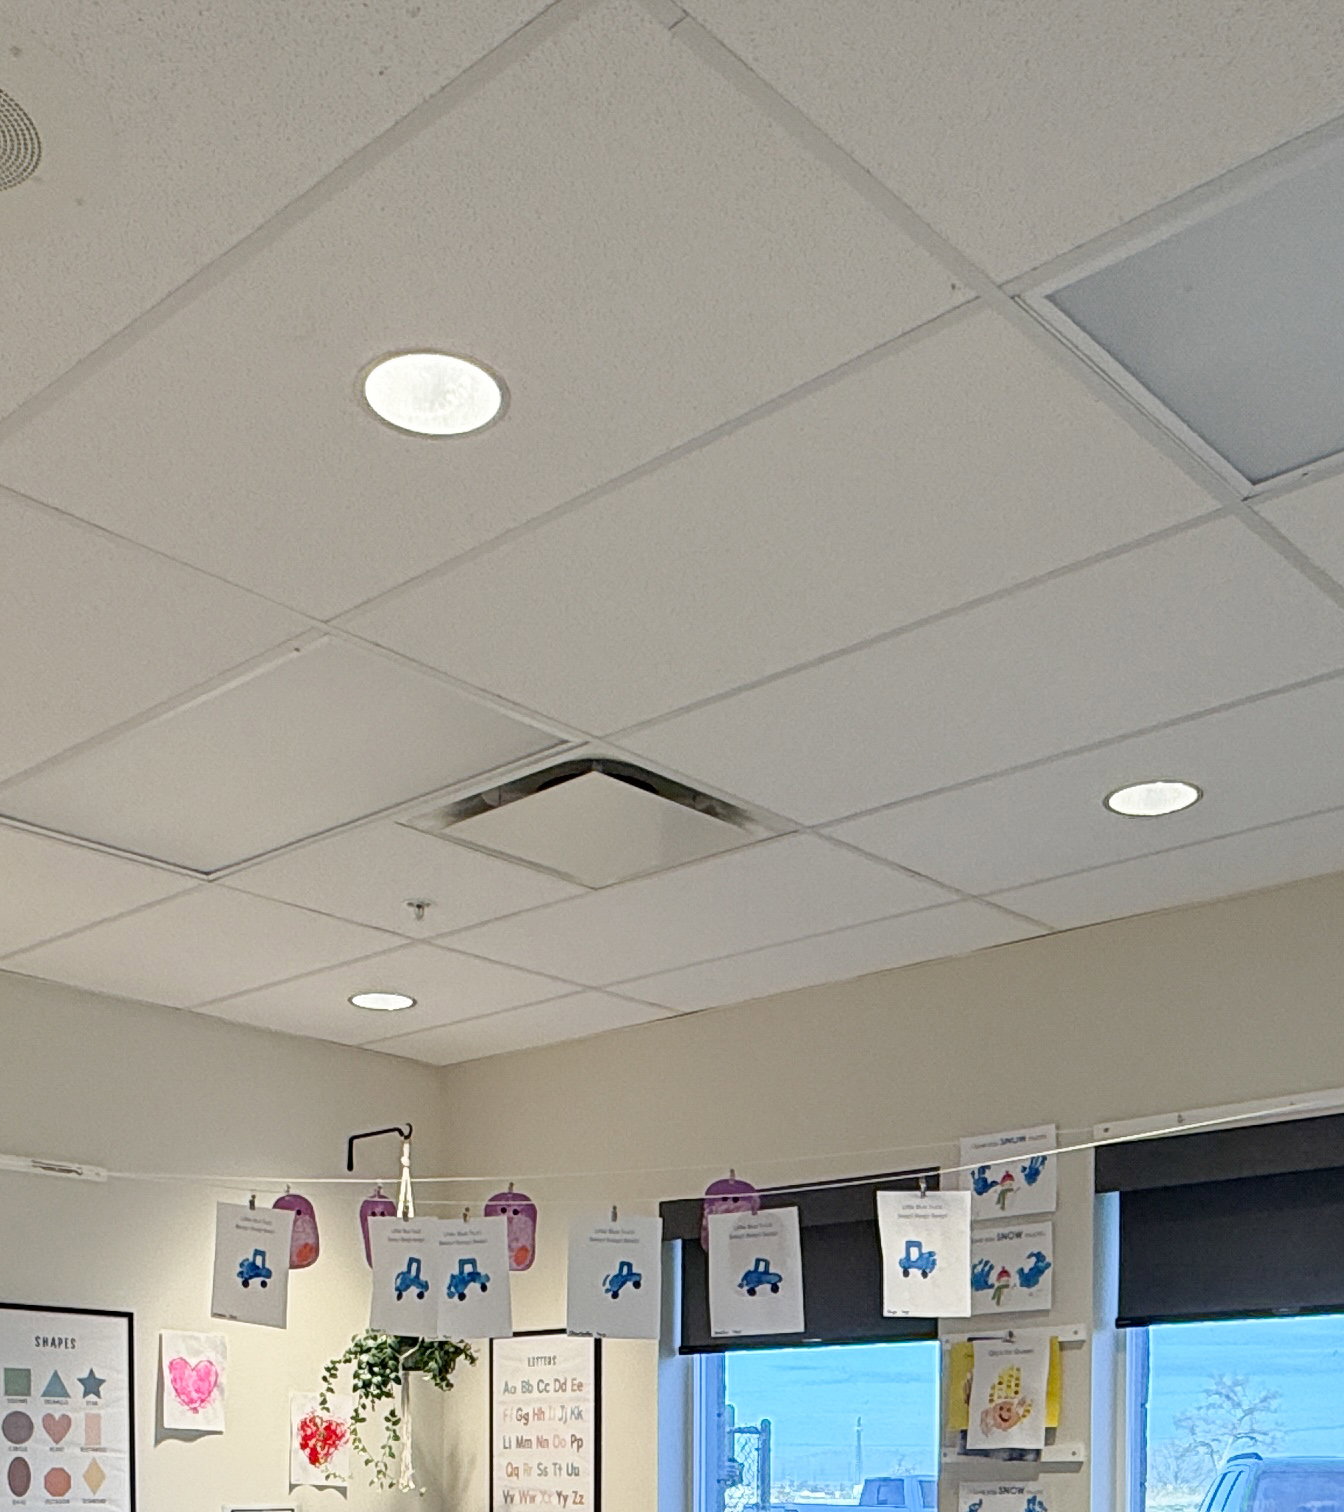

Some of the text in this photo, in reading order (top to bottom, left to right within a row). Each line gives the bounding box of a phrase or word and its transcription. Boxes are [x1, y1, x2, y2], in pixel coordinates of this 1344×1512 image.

[997, 1231, 1023, 1240] SNOW
[34, 1336, 76, 1349] SHAPES
[503, 1378, 583, 1394] Aa Bb Cc Dd Ee
[516, 1407, 529, 1425] Gg
[533, 1407, 545, 1421] Hh
[558, 1405, 568, 1424] Jj
[570, 1406, 583, 1421] Kk
[516, 1435, 532, 1449] Mm
[536, 1435, 549, 1449] Nn
[552, 1434, 566, 1448] Oo
[570, 1434, 583, 1452] Pp
[506, 1462, 519, 1480] Qq
[537, 1462, 548, 1477] Ss
[552, 1462, 562, 1477] Tt
[566, 1462, 579, 1477] Uu
[503, 1490, 514, 1505] Vv
[518, 1490, 536, 1505] Ww
[556, 1490, 568, 1508] Yy
[572, 1491, 584, 1505] Zz
